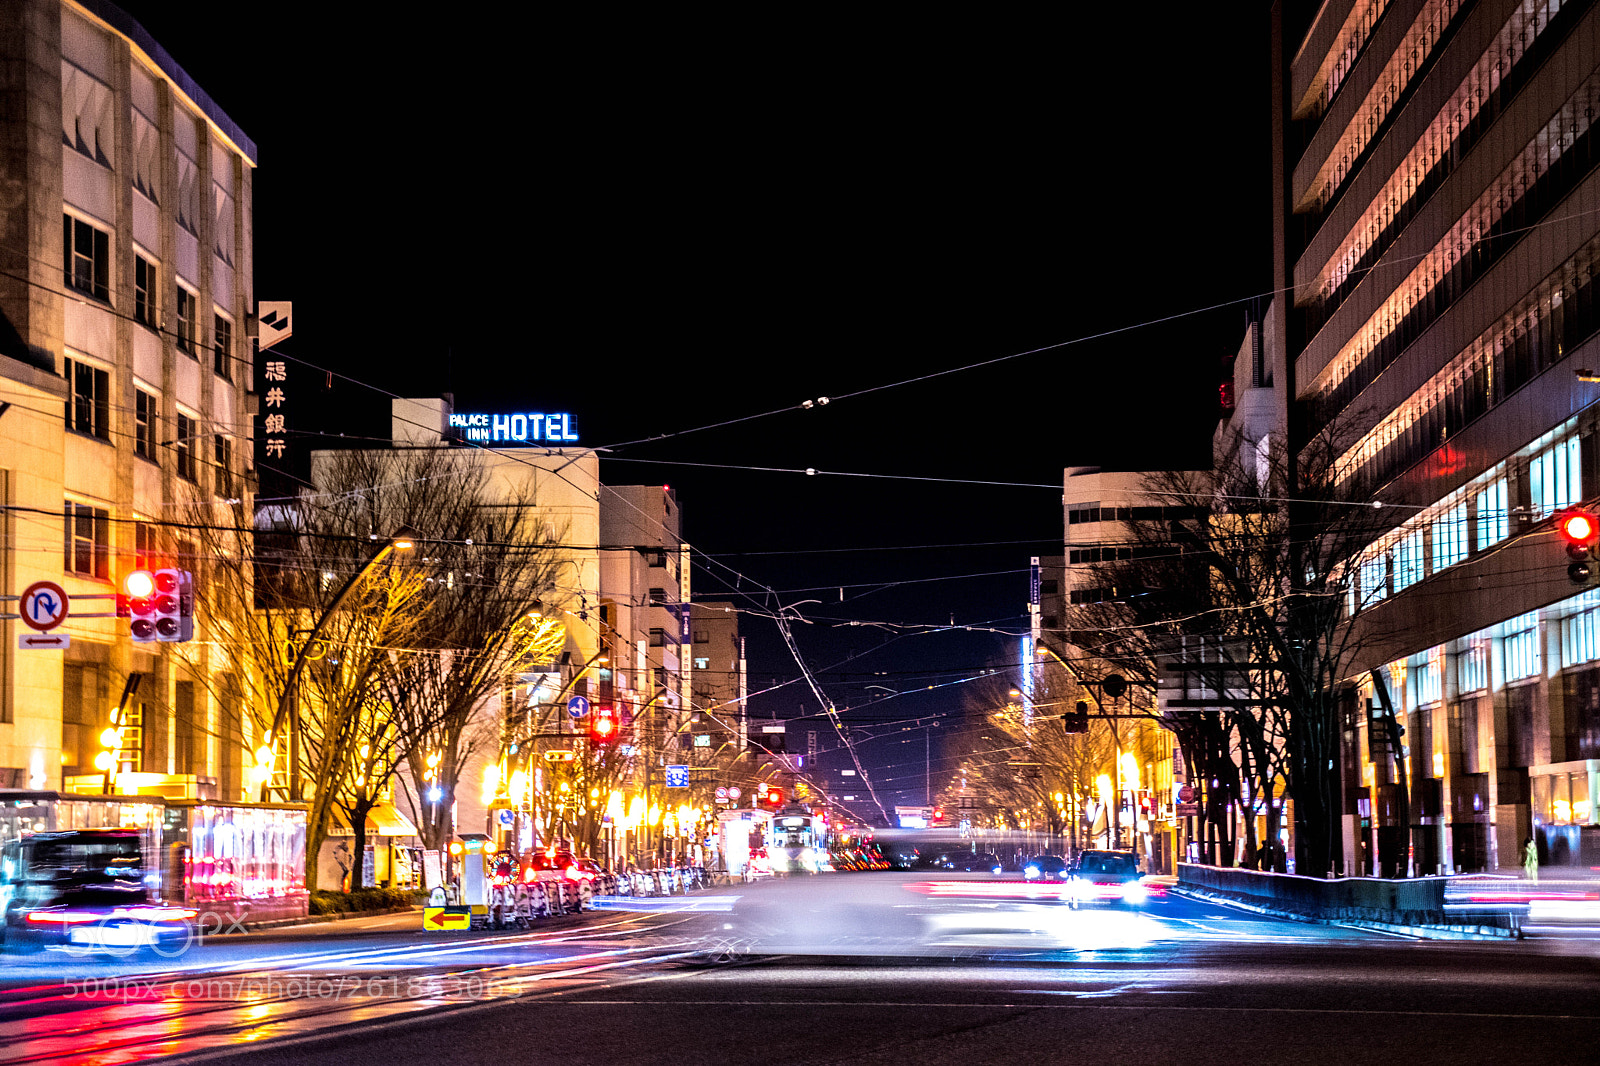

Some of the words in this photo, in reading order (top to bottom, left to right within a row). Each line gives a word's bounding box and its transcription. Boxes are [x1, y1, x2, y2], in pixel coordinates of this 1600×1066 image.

[264, 361, 287, 459] 福井銀行
[449, 414, 489, 427] PALACE
[467, 427, 489, 441] INN
[493, 412, 579, 441] HOTEL
